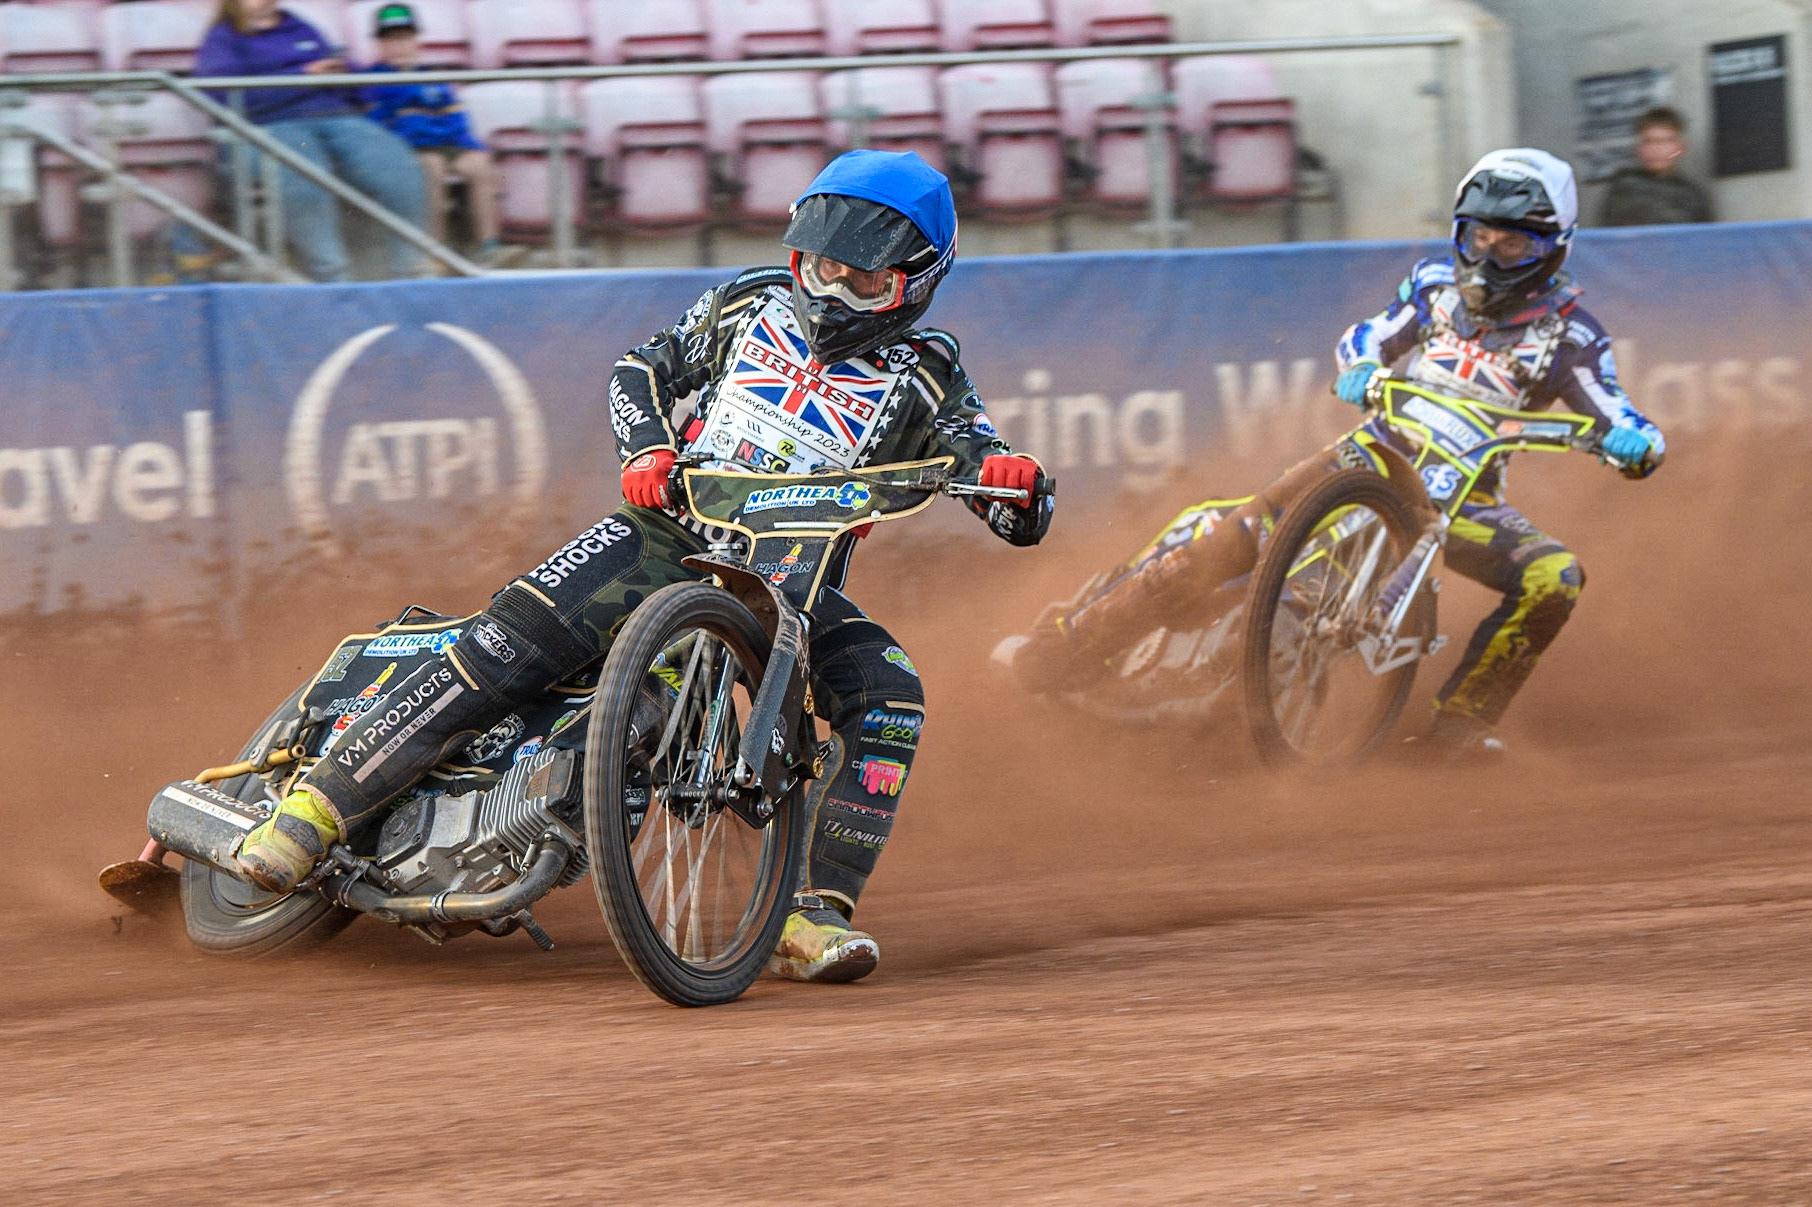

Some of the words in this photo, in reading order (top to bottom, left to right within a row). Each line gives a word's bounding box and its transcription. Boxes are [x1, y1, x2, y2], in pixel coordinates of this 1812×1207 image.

[609, 375, 651, 426] HAGON
[744, 343, 874, 420] BRITISH
[727, 386, 813, 437] Championship
[814, 432, 850, 458] 2023
[334, 417, 500, 506] ATPI
[738, 441, 786, 472] NSSC
[745, 501, 786, 512] DEMOLITION
[539, 522, 632, 588] SHOCKS
[755, 560, 816, 575] HAGON
[365, 648, 398, 656] DEMOLITION
[323, 693, 388, 717] HAGO
[338, 738, 368, 767] VM
[363, 668, 452, 745] PRODUCTS
[382, 739, 401, 756] NOW
[400, 729, 412, 740] OR
[410, 706, 437, 731] NEVER
[860, 736, 877, 744] FAST
